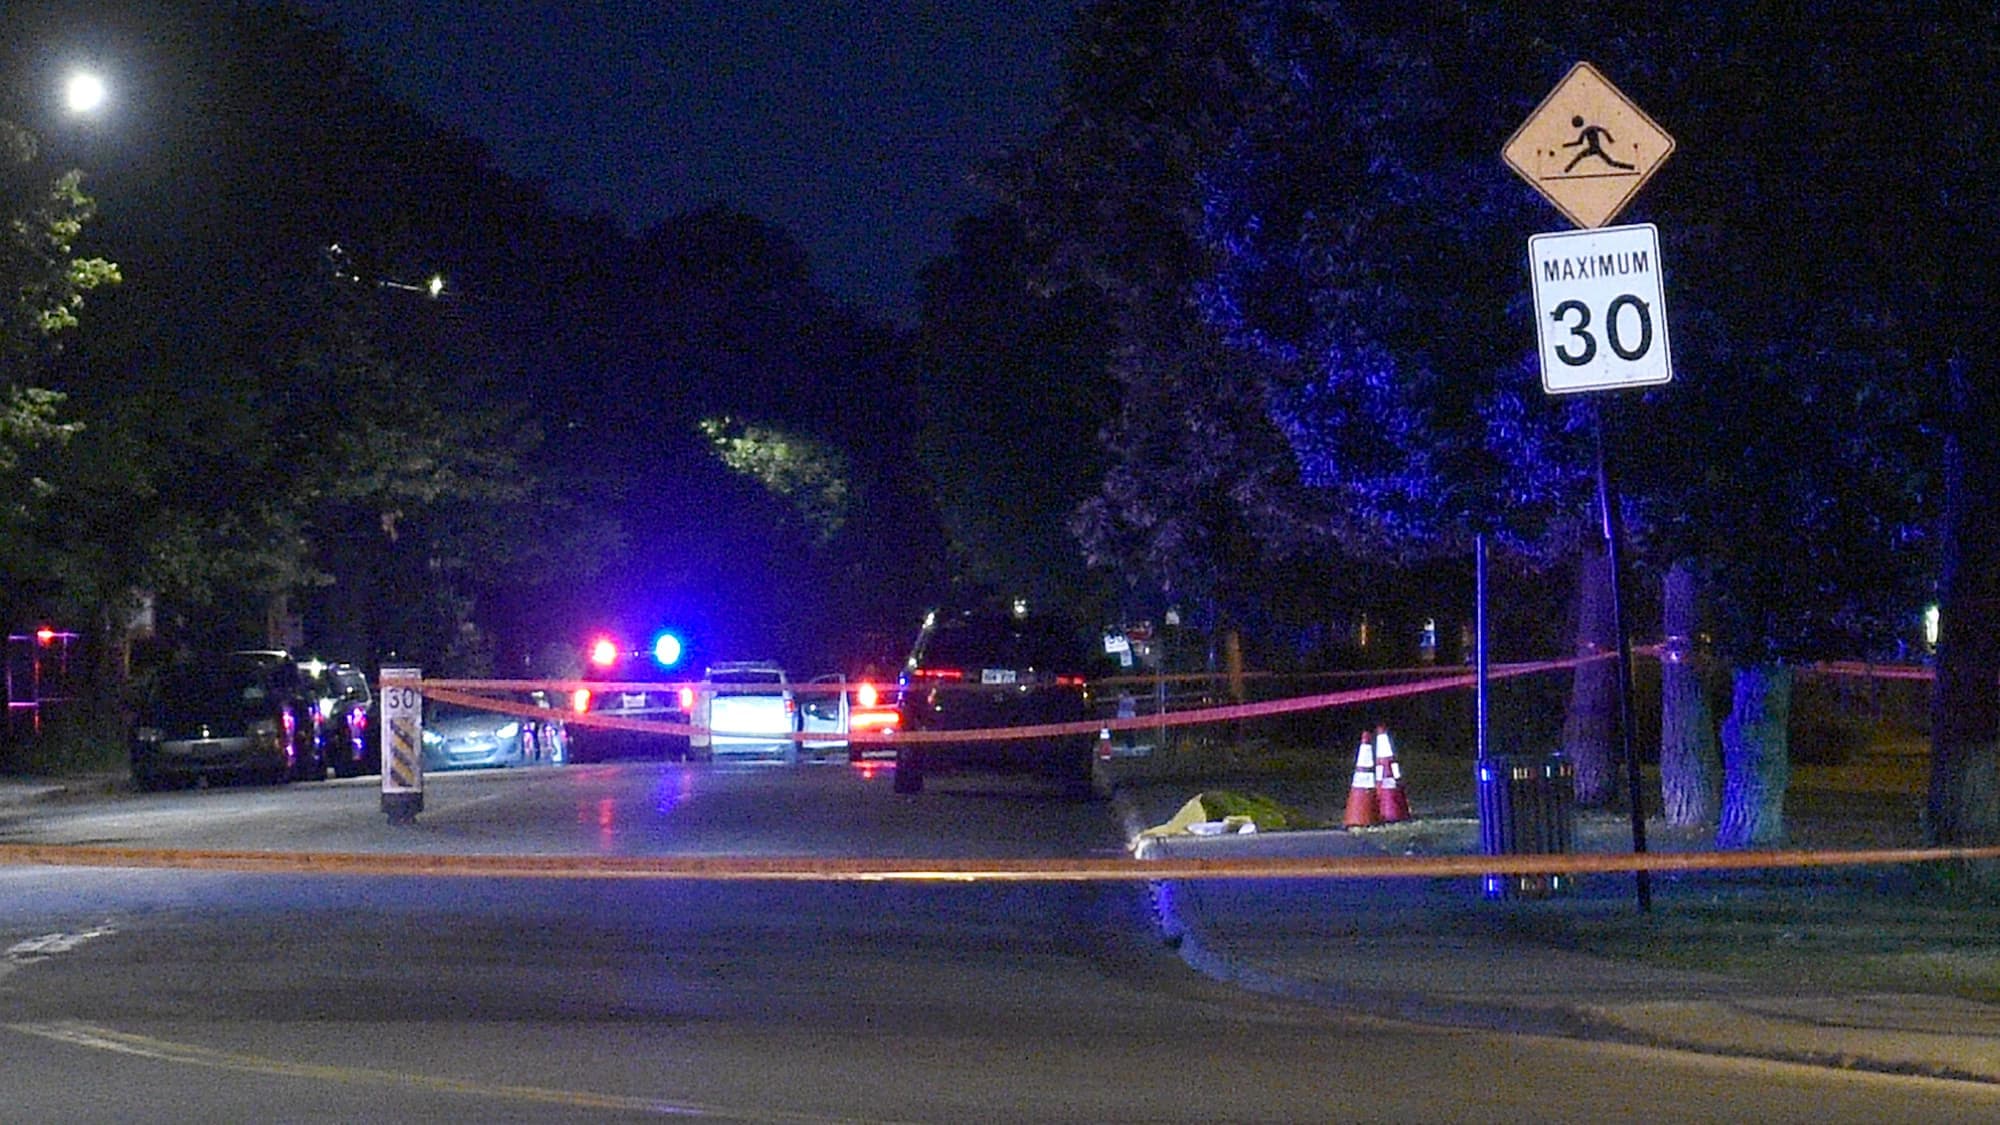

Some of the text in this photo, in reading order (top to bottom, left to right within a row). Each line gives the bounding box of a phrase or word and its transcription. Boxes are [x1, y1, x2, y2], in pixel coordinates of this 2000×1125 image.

[1543, 250, 1649, 282] MAXIMUM
[1551, 293, 1653, 367] 30
[389, 686, 415, 709] 30
